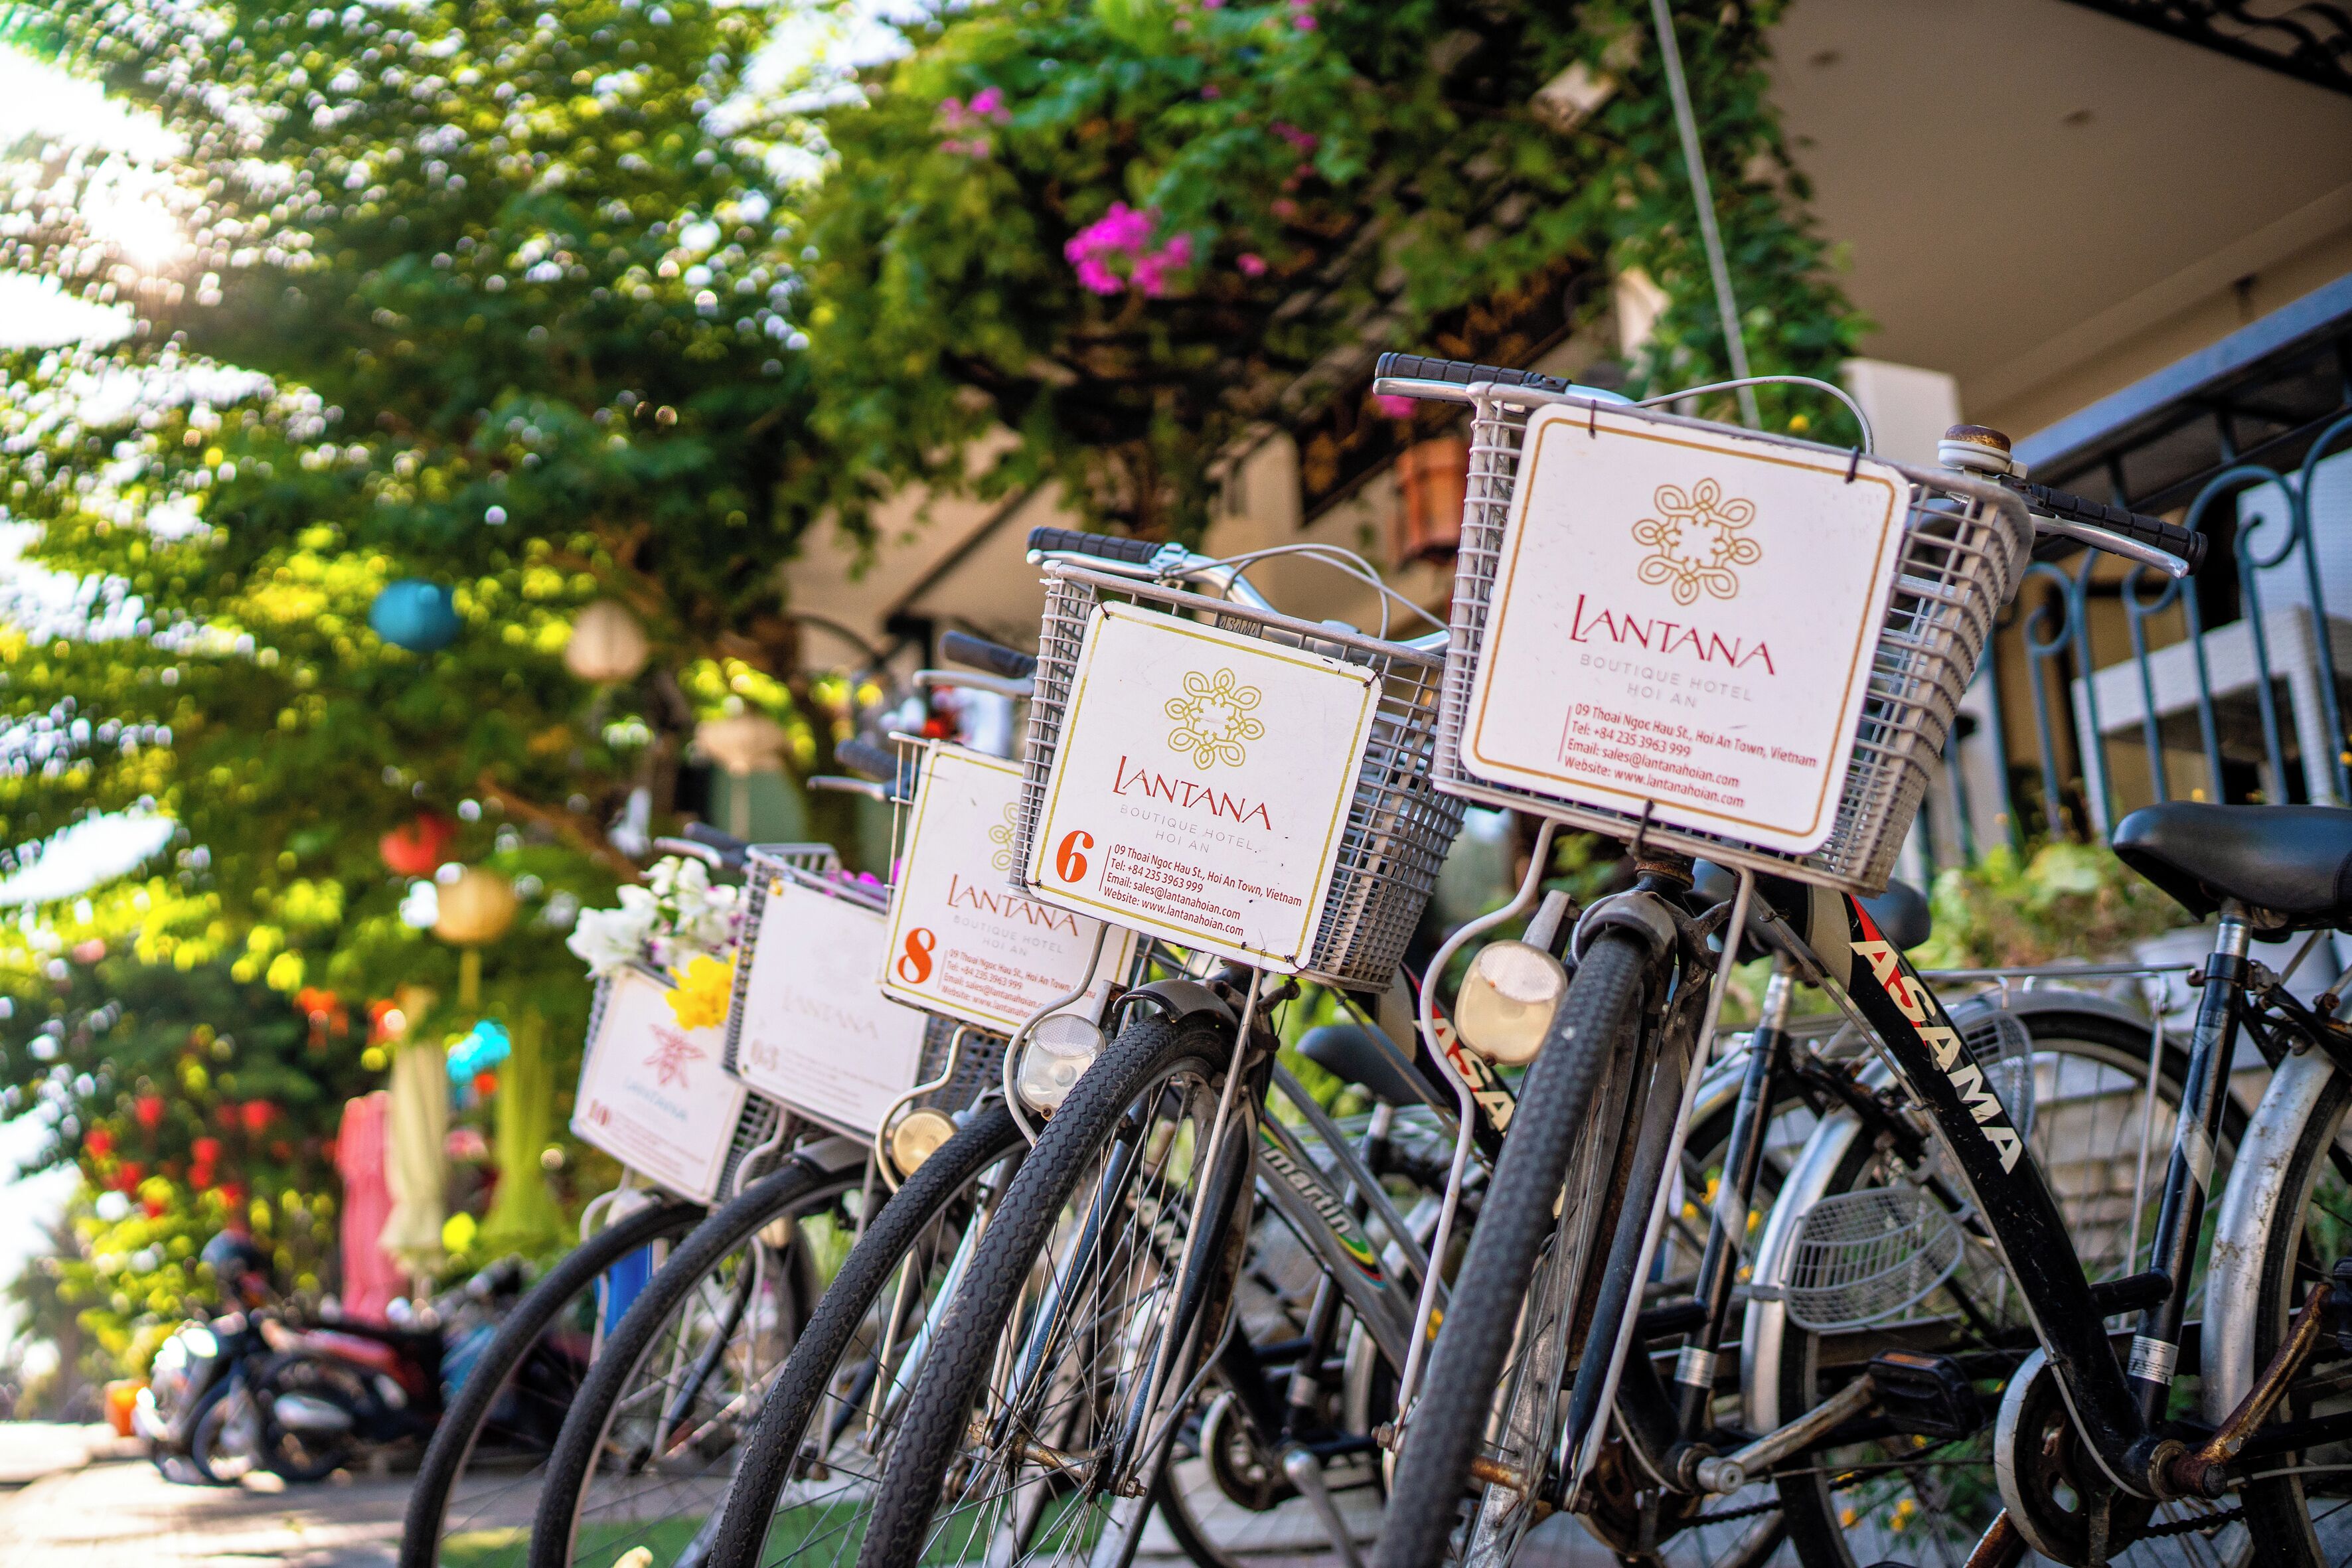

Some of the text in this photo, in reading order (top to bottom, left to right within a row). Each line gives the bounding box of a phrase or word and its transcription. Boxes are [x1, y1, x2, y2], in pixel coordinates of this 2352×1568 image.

[1569, 594, 1775, 675] LANTANA
[1579, 654, 1753, 702] BOUTIQUE HOTEL
[1627, 683, 1696, 708] HOI AN
[1572, 720, 1691, 757] Tel: +84 235 3963 999
[1575, 703, 1817, 767] 09 Thoai Ngoc Hau St., Hoi An Town, Vietnam
[1565, 755, 1745, 807] Website: www.lantanahoian.com
[1567, 738, 1739, 787] Email: sales@lantanahoian.com
[1113, 755, 1271, 830] LANTANA
[1120, 804, 1253, 851] BOUTIQUE HOTEL
[1155, 830, 1210, 853] HOI AN
[1056, 830, 1094, 883] 6
[1111, 858, 1204, 893] Tel: +84 235 3963 999
[1114, 844, 1302, 907] 09 Thoai Ngoc Hau St., Hoi An Town, Vietnam
[947, 874, 1078, 937] LANTANA
[1104, 886, 1243, 936] Website: www.lantanahoian.com
[1107, 872, 1241, 920] Email: sales@lantanahoian.com
[897, 927, 936, 984] 8
[953, 915, 1063, 954] BOUTIQUE HOTEL
[982, 937, 1028, 957] HOI AN
[1411, 1018, 1517, 1133] ASA
[1848, 941, 2023, 1174] ASAMA
[1263, 1148, 1351, 1235] martin
